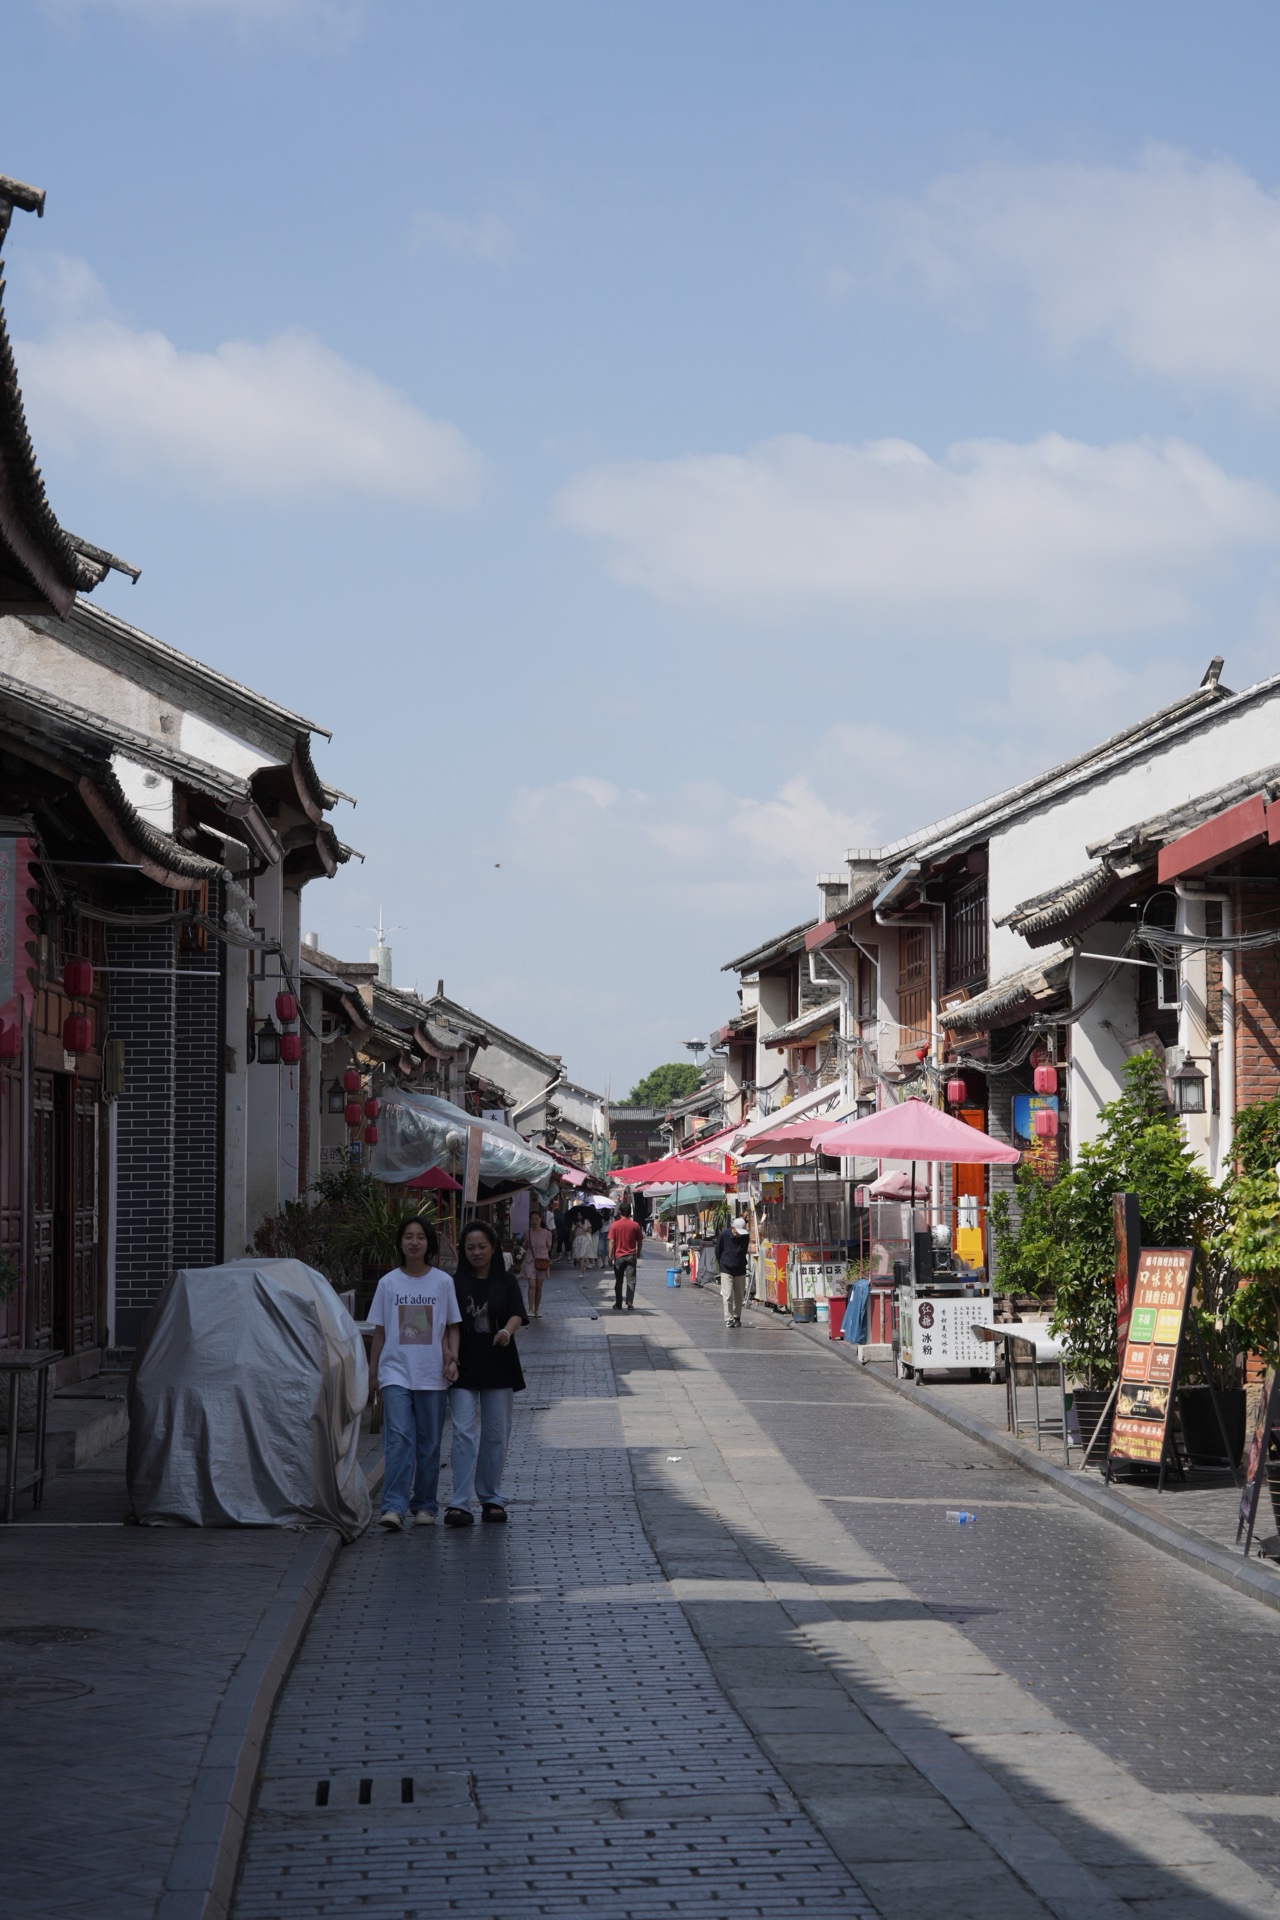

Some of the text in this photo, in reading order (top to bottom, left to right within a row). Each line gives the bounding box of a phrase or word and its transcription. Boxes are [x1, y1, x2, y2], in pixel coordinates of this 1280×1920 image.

[1139, 1268, 1188, 1289] 口味定制
[1137, 1313, 1151, 1325] 不辣
[1156, 1353, 1170, 1366] 中辣
